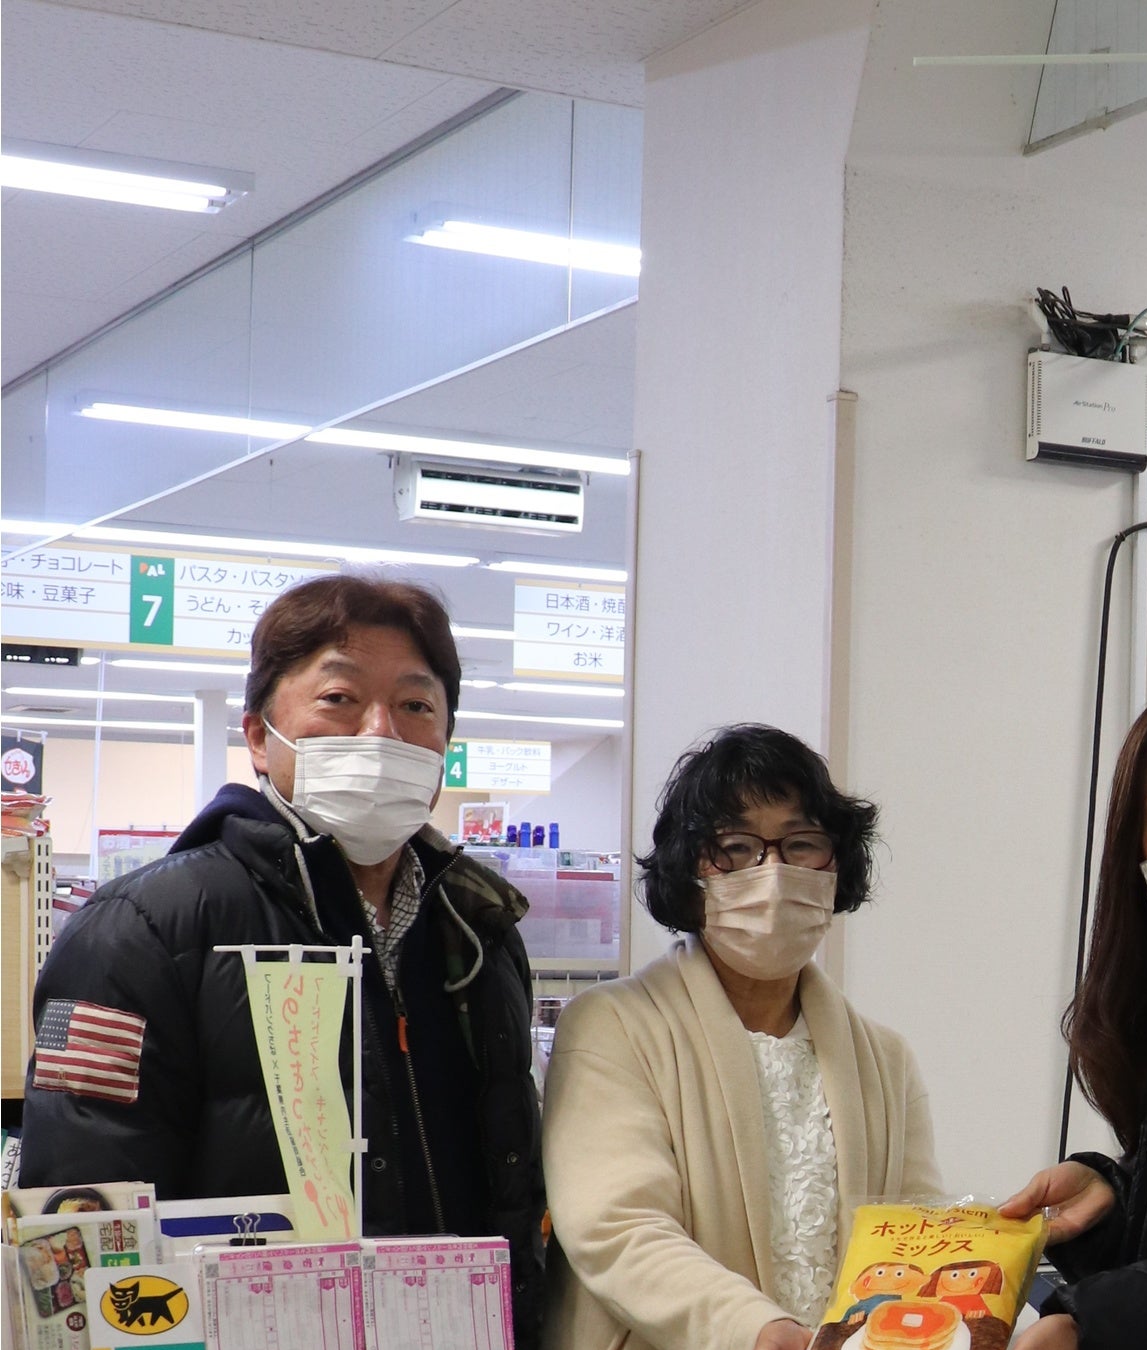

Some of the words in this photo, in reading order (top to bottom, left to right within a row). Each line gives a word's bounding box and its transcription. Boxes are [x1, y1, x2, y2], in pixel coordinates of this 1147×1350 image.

[139, 562, 166, 577] PAL
[141, 594, 163, 627] 7
[187, 594, 271, 616] うどん・そ
[573, 651, 603, 668] お米
[450, 761, 463, 779] 4
[489, 761, 529, 771] ヨーグルト
[892, 1239, 973, 1257] ミックス
